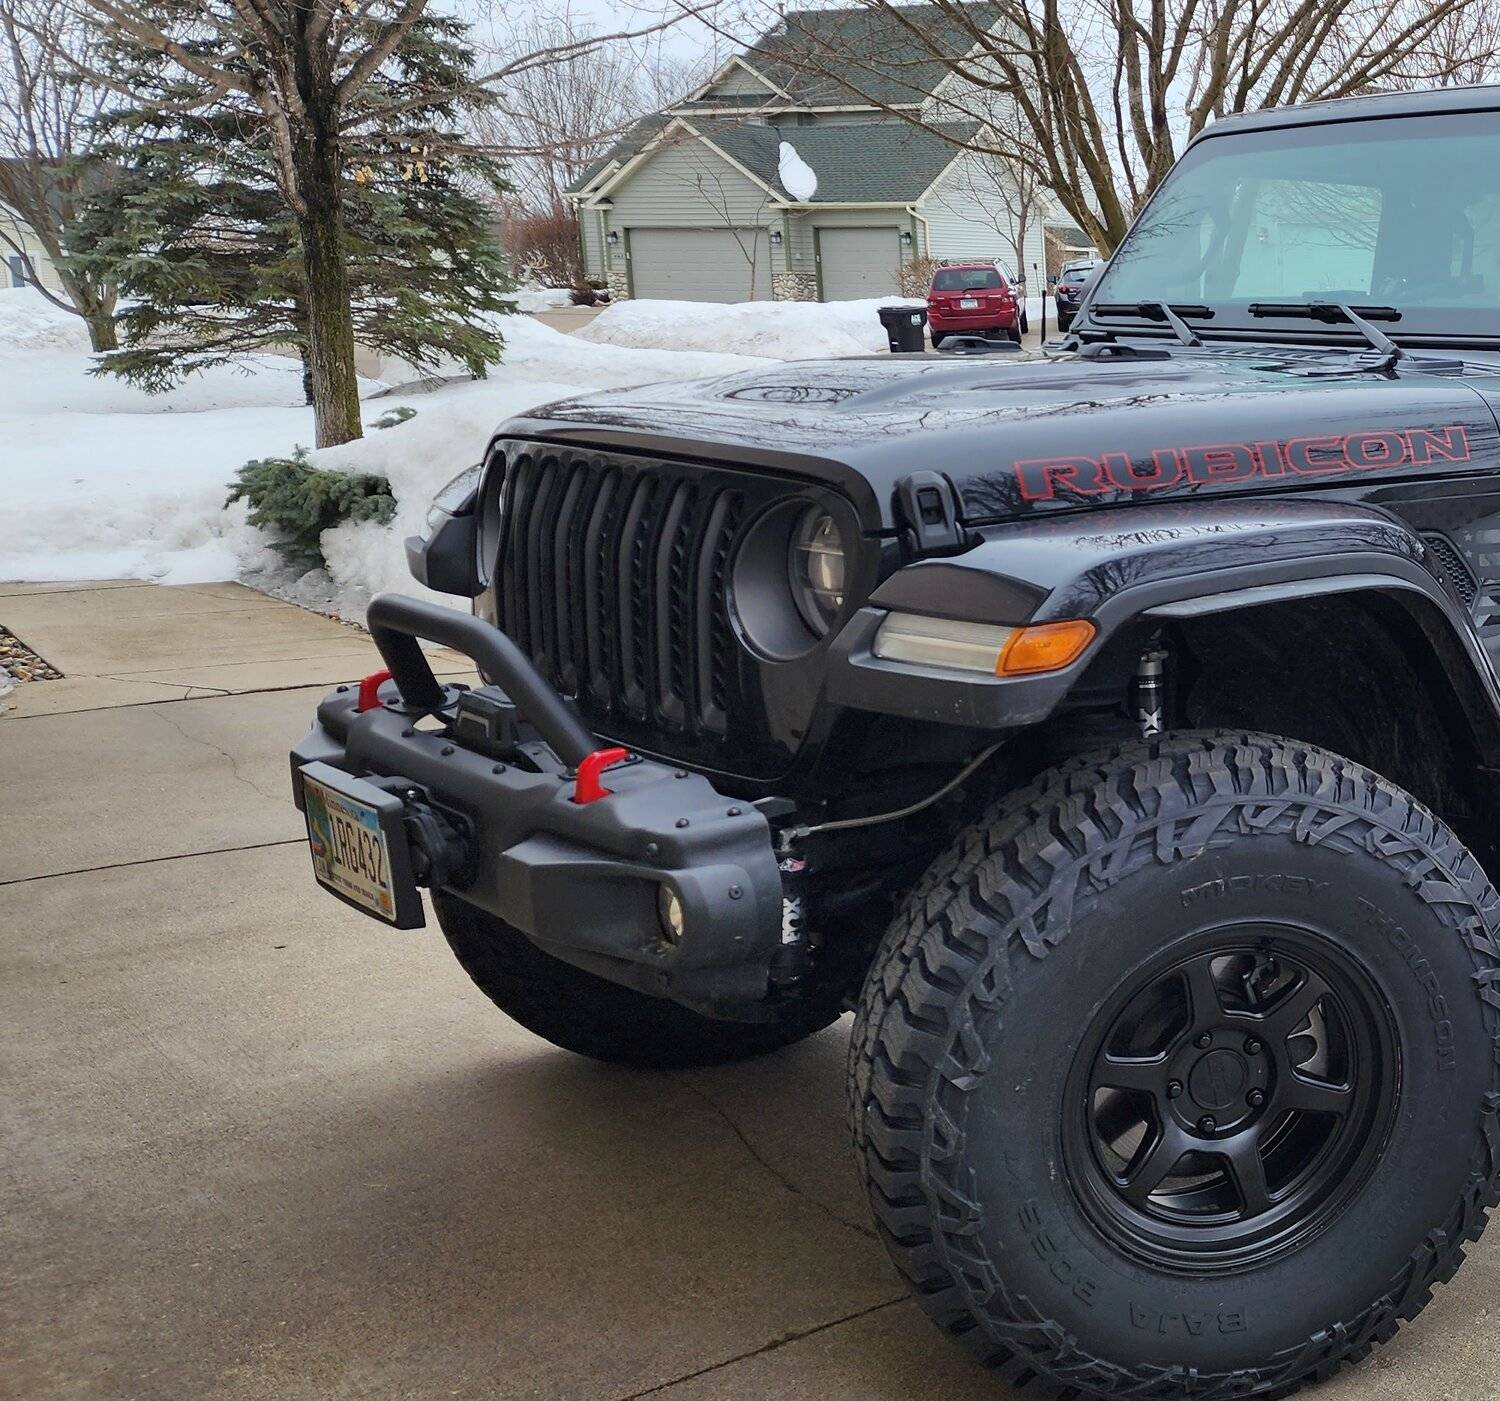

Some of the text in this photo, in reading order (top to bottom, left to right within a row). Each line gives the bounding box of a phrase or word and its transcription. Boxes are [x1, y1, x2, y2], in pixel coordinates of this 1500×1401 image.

[1013, 426, 1471, 500] RUBICON
[782, 897, 801, 944] FOX
[1128, 1300, 1248, 1336] BAJA
